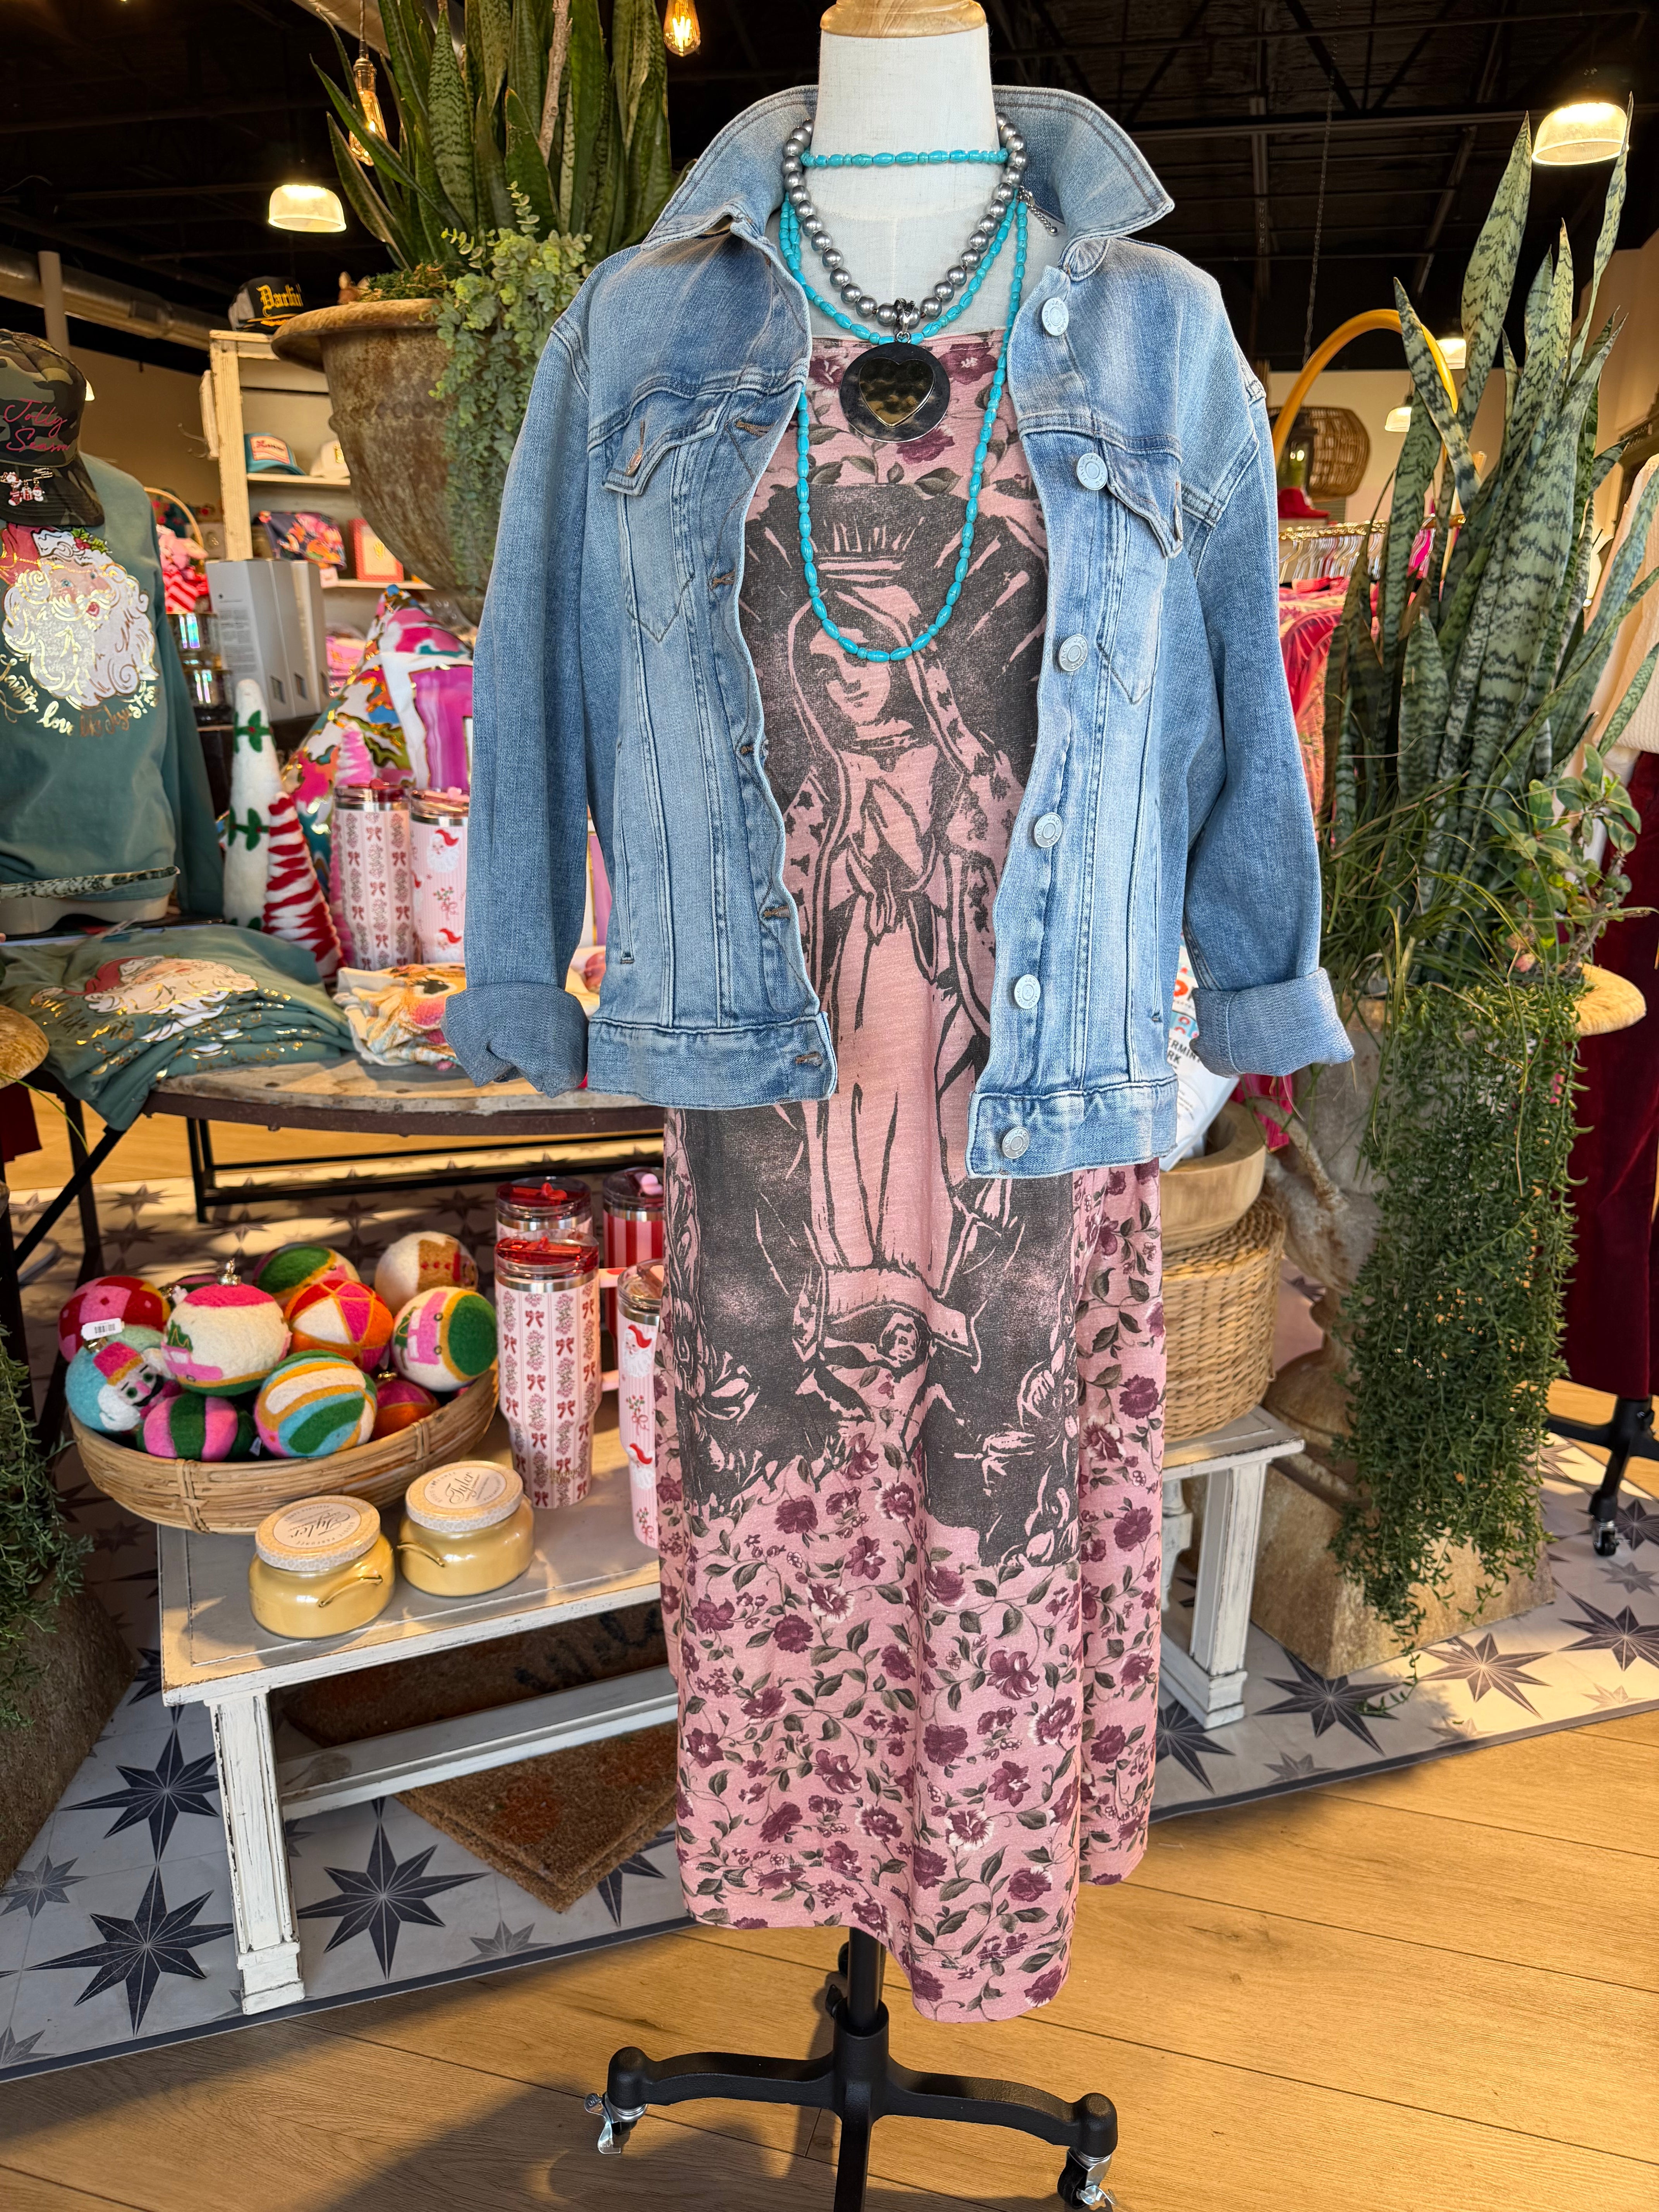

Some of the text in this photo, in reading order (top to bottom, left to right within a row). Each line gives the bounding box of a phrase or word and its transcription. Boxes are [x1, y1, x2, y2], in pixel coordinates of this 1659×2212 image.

[4, 398, 68, 438] Jolly
[6, 428, 70, 452] Season
[36, 701, 74, 735] love
[445, 1472, 477, 1504] Tyler
[288, 1513, 350, 1538] Tyler
